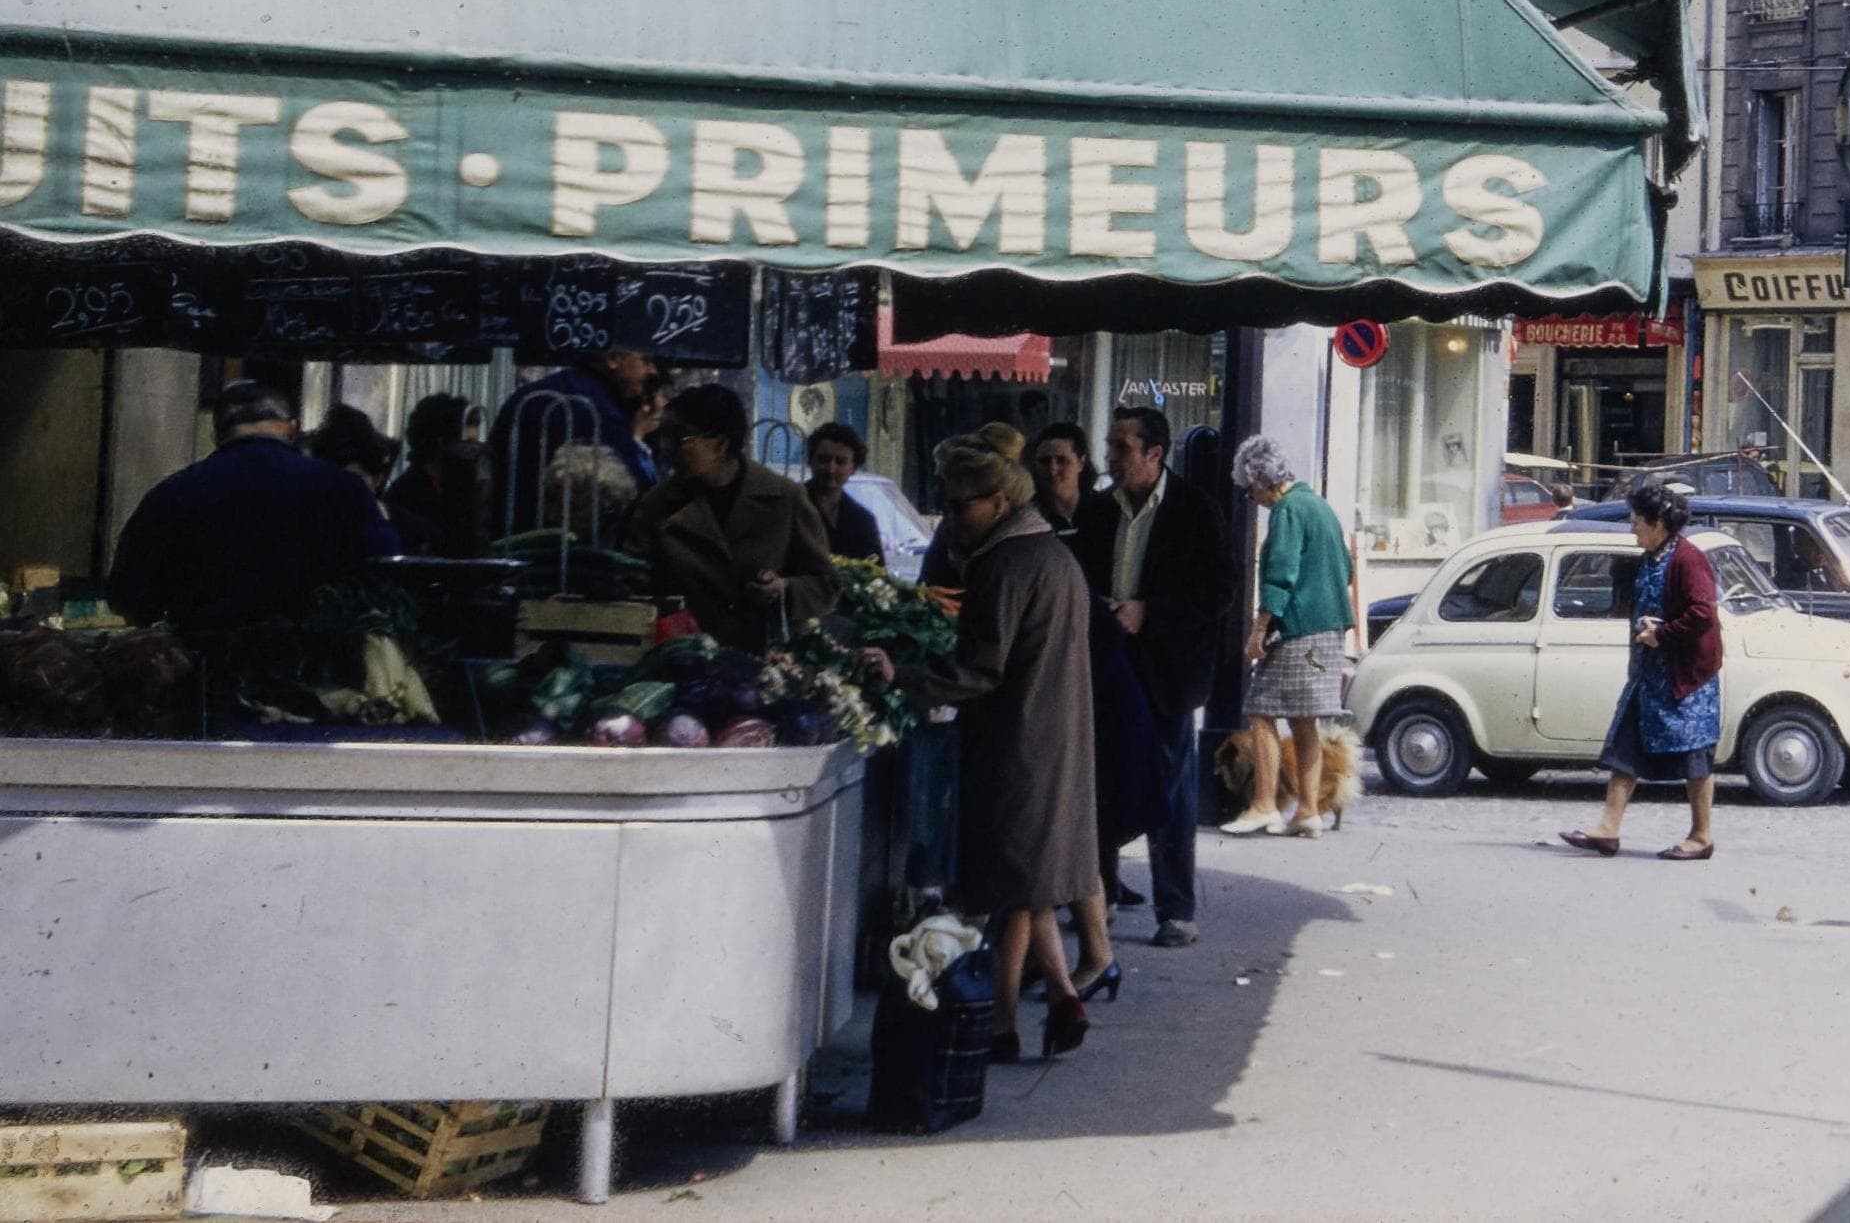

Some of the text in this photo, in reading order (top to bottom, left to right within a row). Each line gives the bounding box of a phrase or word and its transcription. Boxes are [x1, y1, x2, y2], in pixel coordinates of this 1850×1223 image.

[551, 111, 1547, 267] PRIMEURS
[1525, 322, 1604, 344] BOUCHERIE
[1118, 378, 1207, 403] LANCASTER
